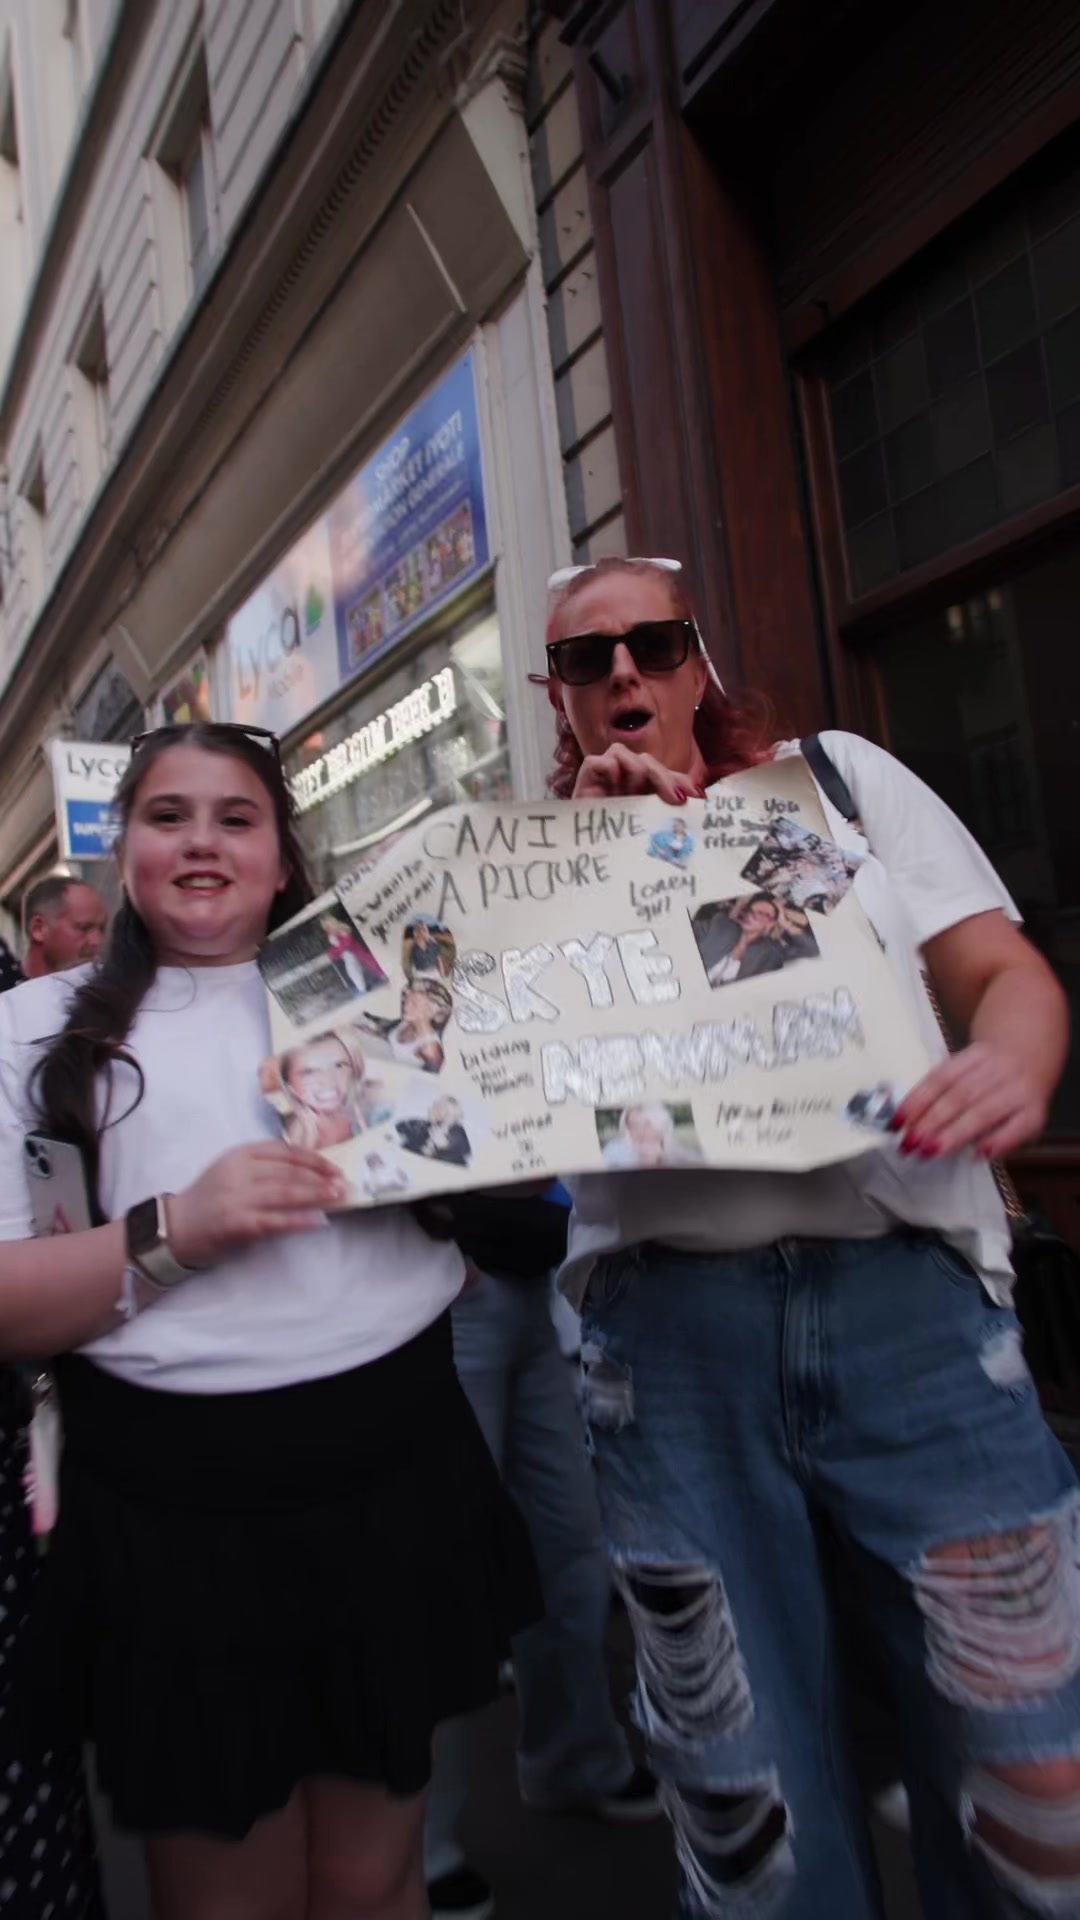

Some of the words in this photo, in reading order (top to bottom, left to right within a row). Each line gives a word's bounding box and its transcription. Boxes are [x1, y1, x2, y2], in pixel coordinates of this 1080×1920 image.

[422, 812, 520, 861] CAN
[526, 815, 558, 849] I
[573, 807, 646, 847] HAVE
[436, 868, 468, 922] A
[478, 852, 611, 909] PICTURE
[450, 928, 683, 1034] SKYE
